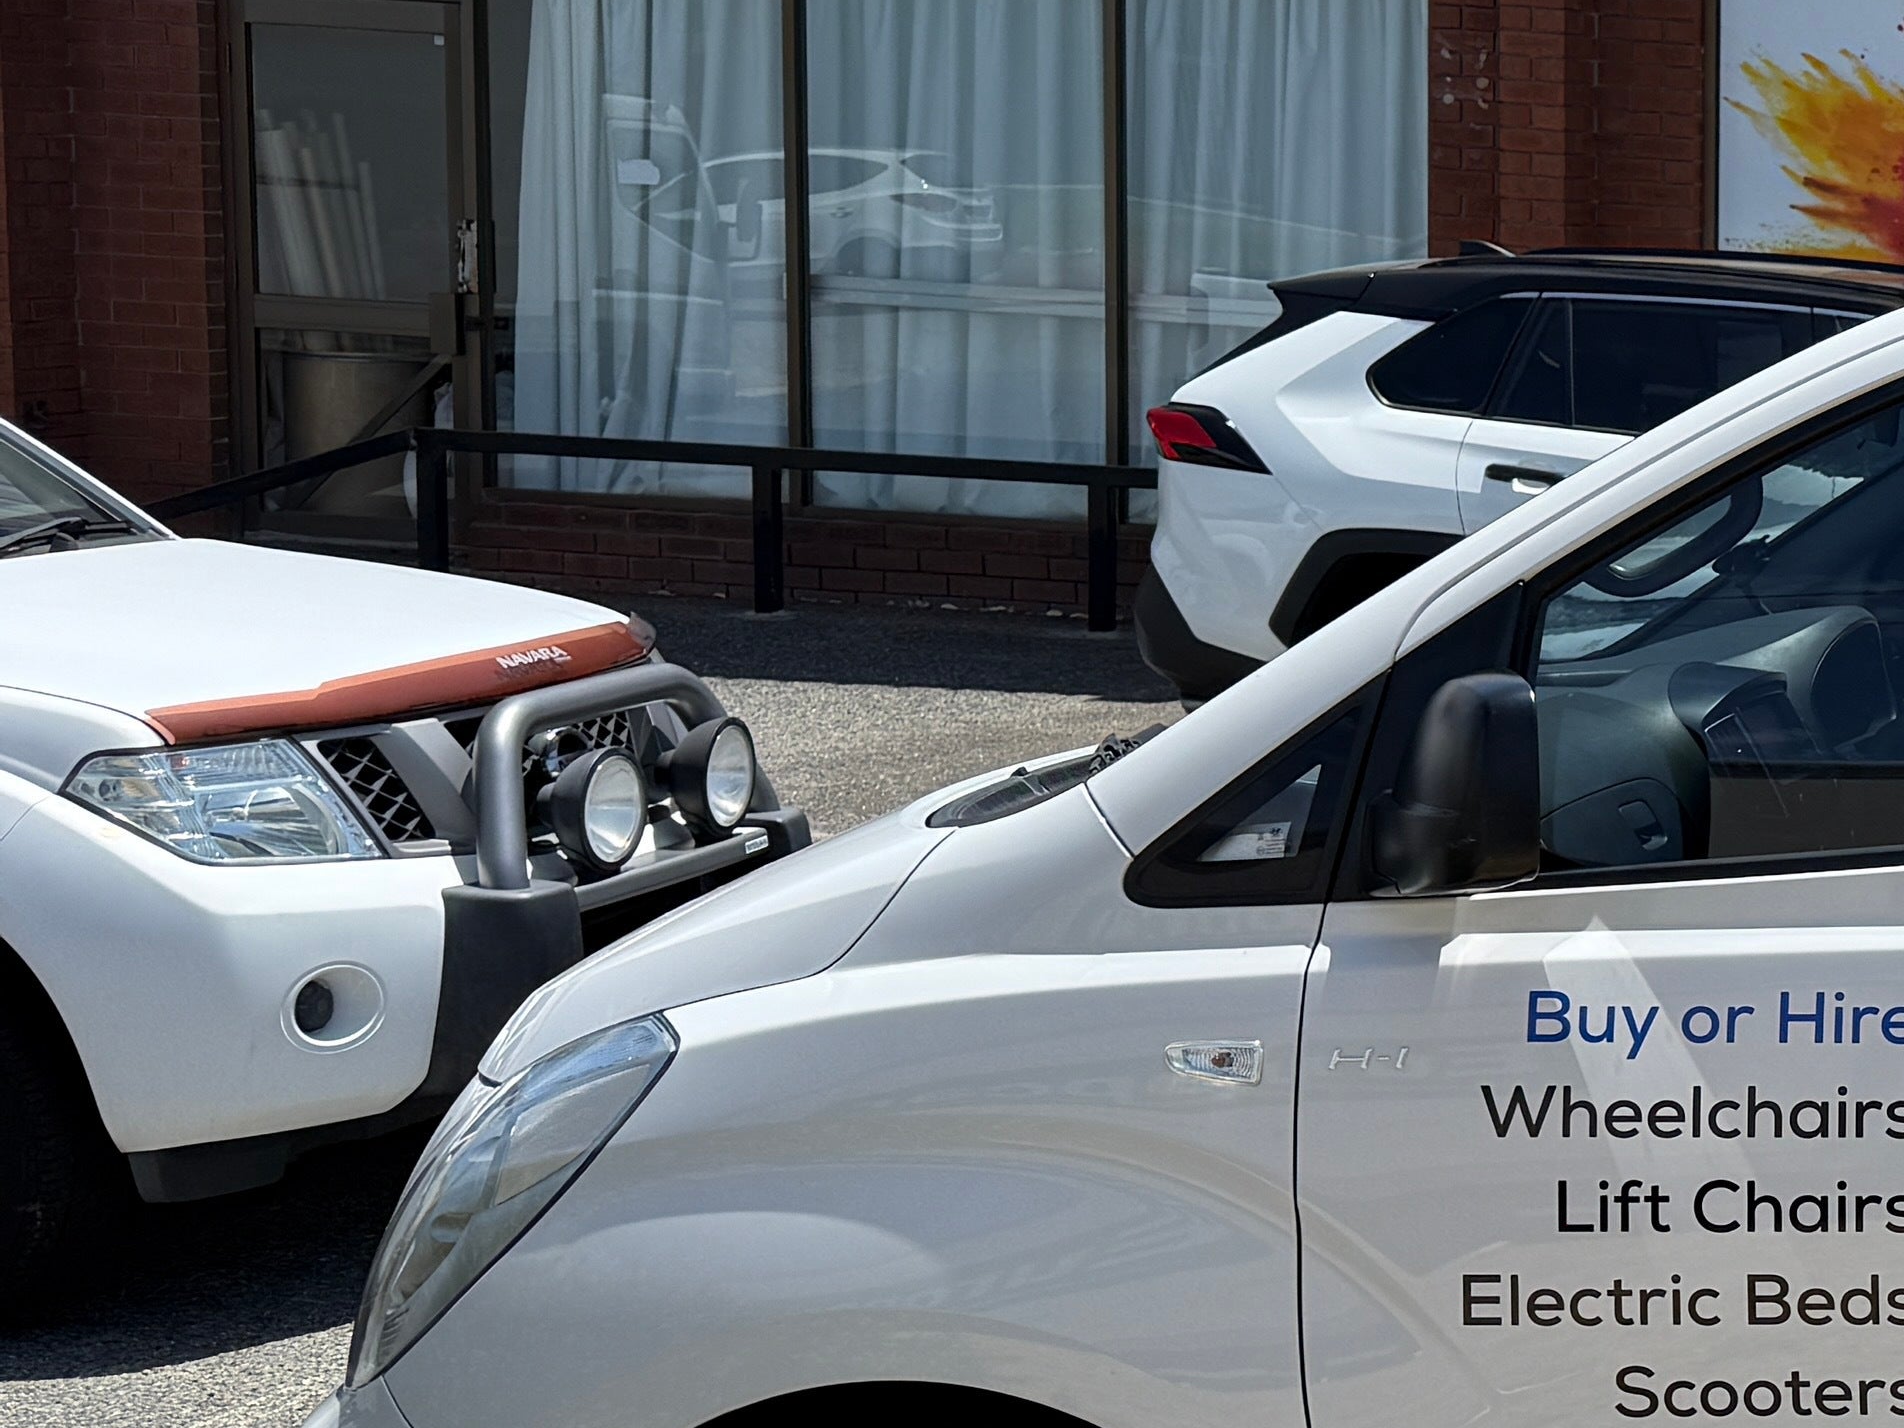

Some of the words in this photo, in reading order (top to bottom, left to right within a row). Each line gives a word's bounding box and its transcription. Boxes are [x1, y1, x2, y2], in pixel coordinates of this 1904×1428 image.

[496, 645, 568, 669] NAVARA
[1527, 991, 1659, 1059] Buy
[1682, 1006, 1754, 1043] or
[1558, 1180, 1670, 1232] Lift
[1463, 1274, 1720, 1326] Electric
